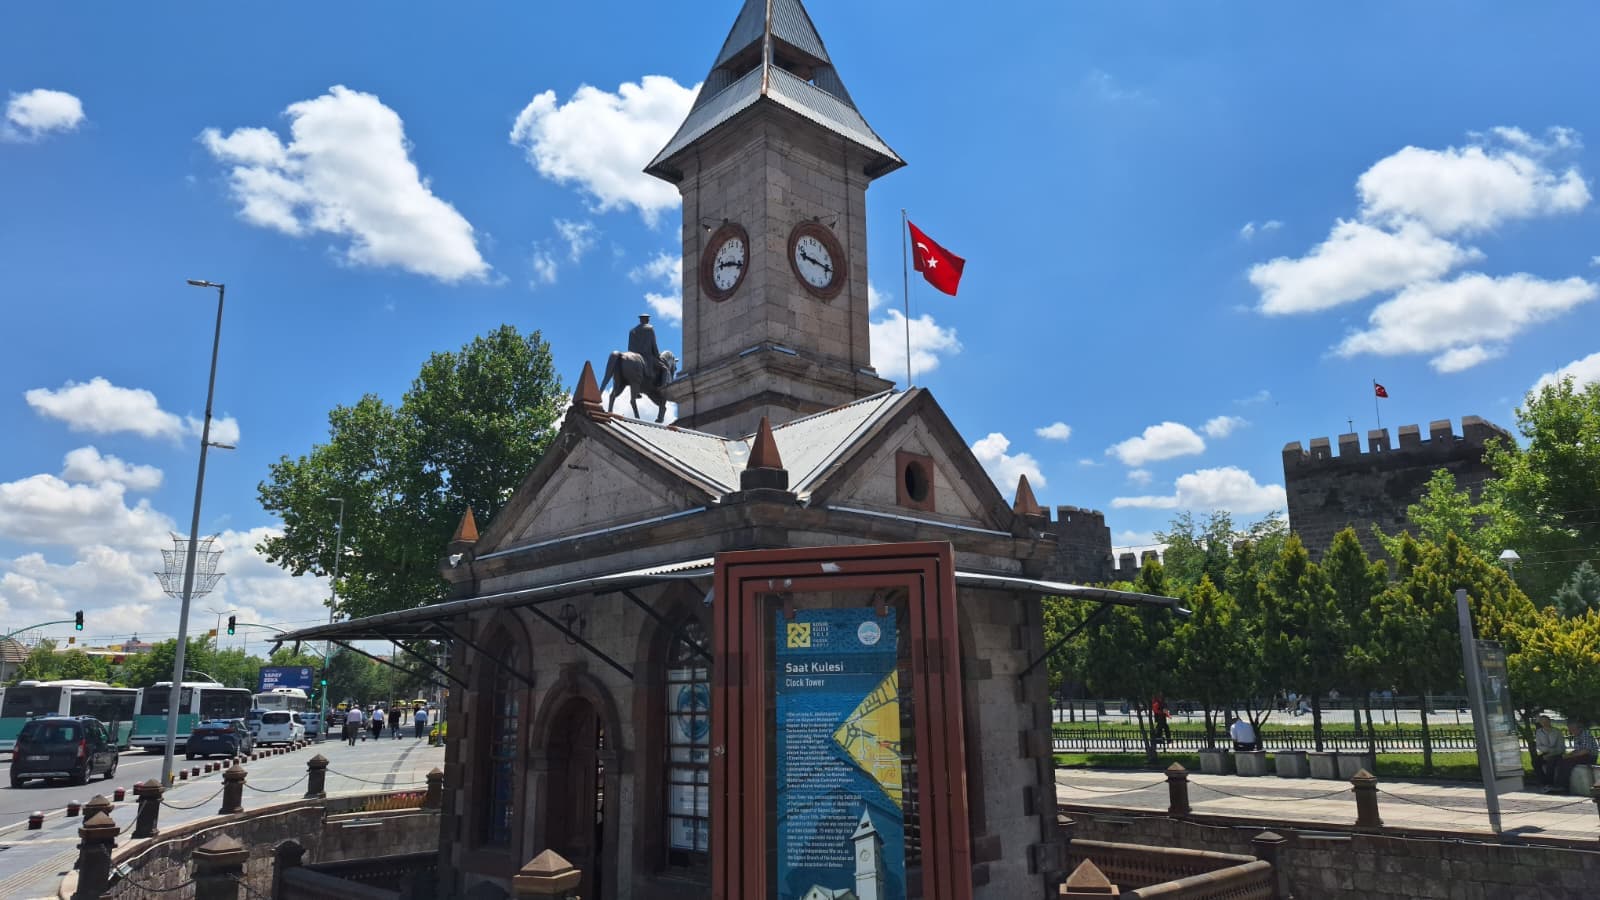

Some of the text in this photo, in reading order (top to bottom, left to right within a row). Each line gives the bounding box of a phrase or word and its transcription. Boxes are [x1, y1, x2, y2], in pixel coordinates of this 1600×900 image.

[785, 661, 844, 673] Saat Kulesi
[785, 678, 824, 687] Clock Tower
